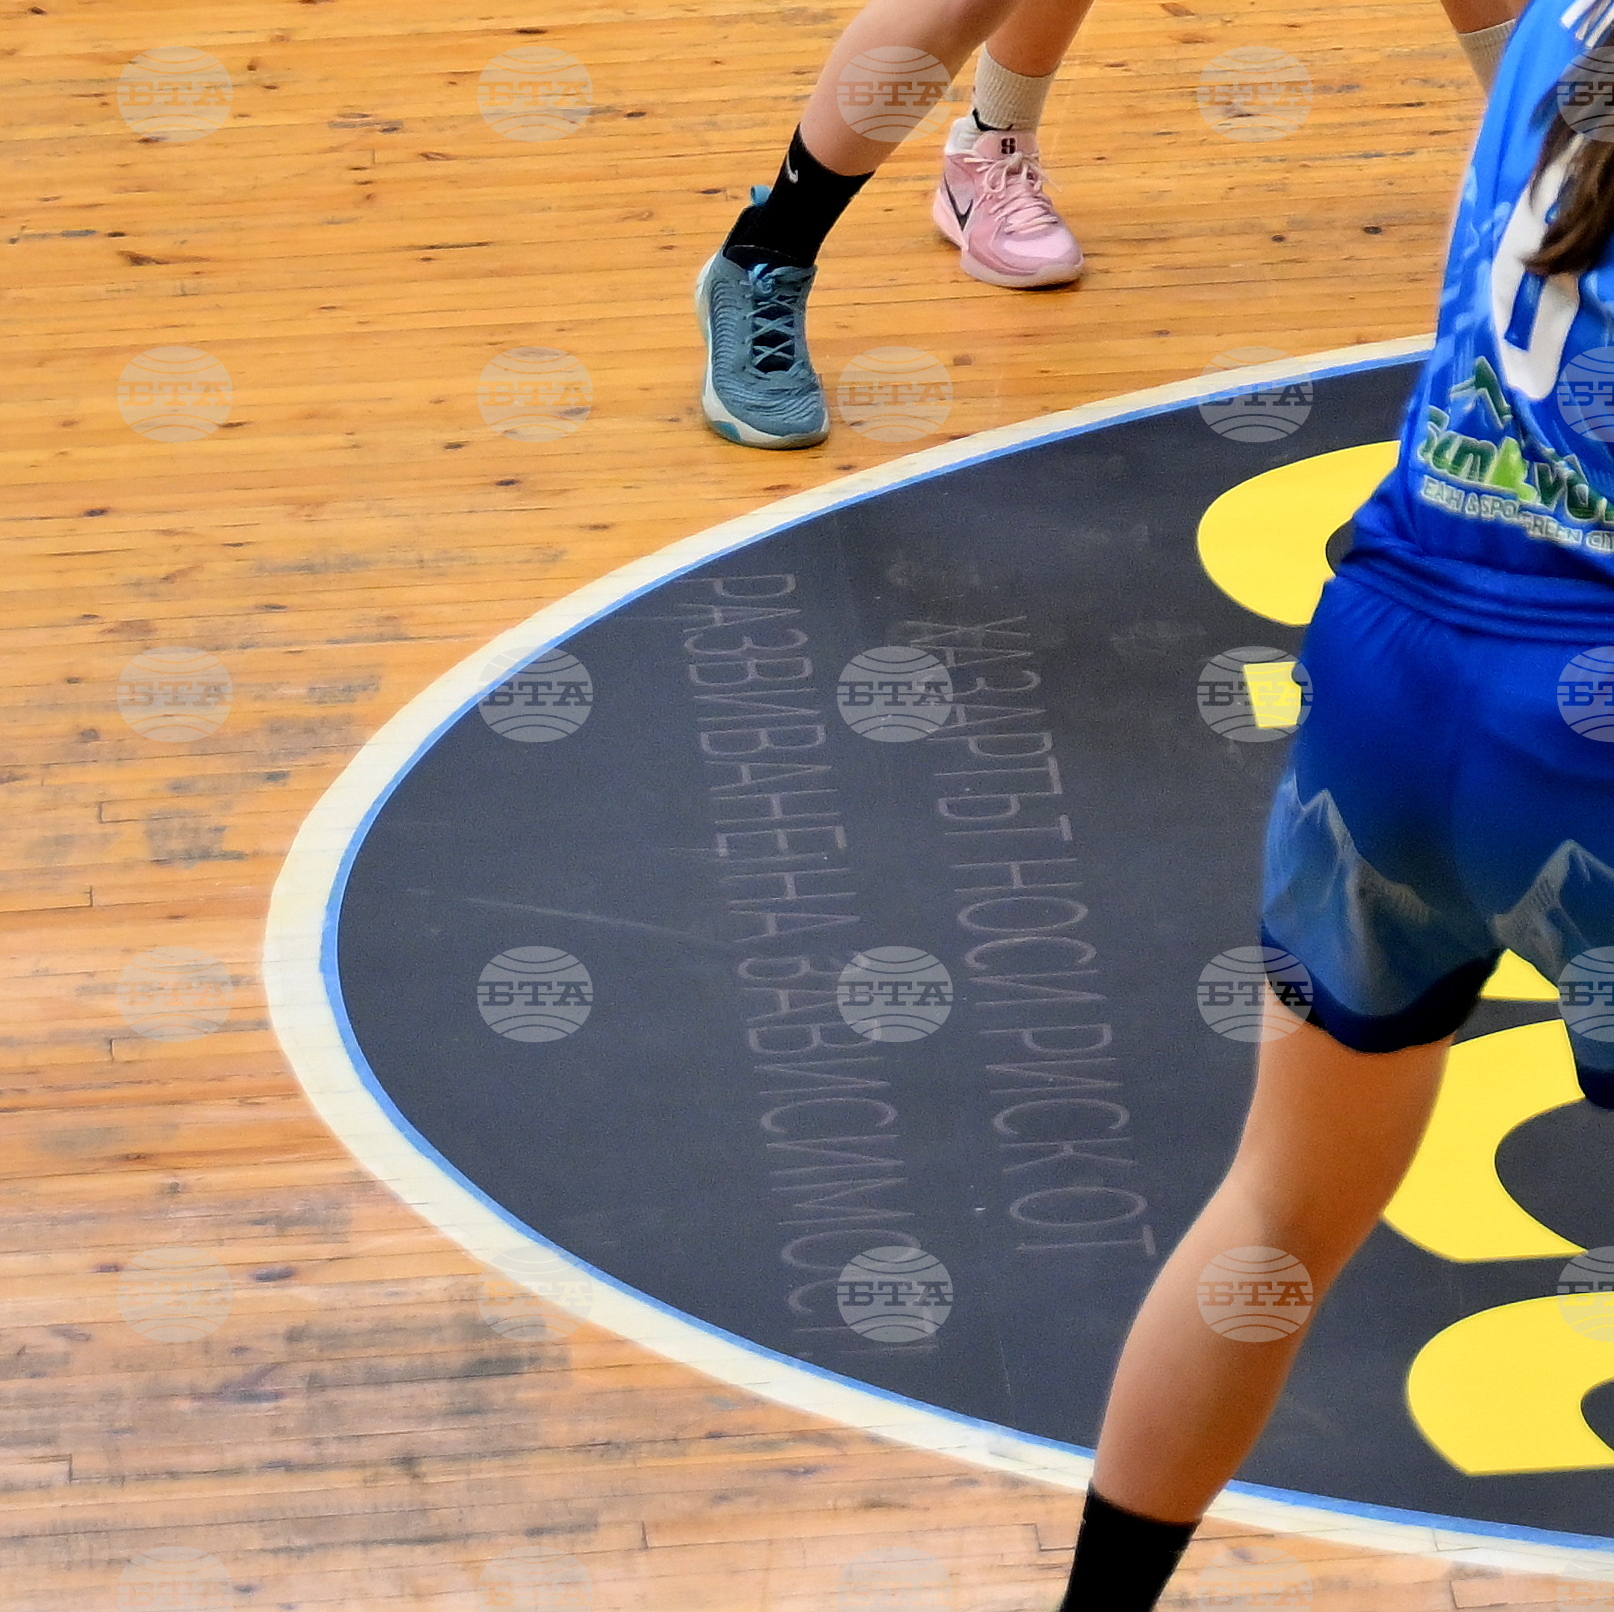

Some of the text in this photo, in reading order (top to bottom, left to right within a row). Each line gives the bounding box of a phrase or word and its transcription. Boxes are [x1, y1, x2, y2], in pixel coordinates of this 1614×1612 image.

[681, 573, 848, 859] РАЗВИВАНЕ
[720, 867, 863, 944] НА
[951, 858, 1102, 1010] НОСИ
[980, 1024, 1136, 1175] РИСК
[1009, 1186, 1156, 1258] ОТ
